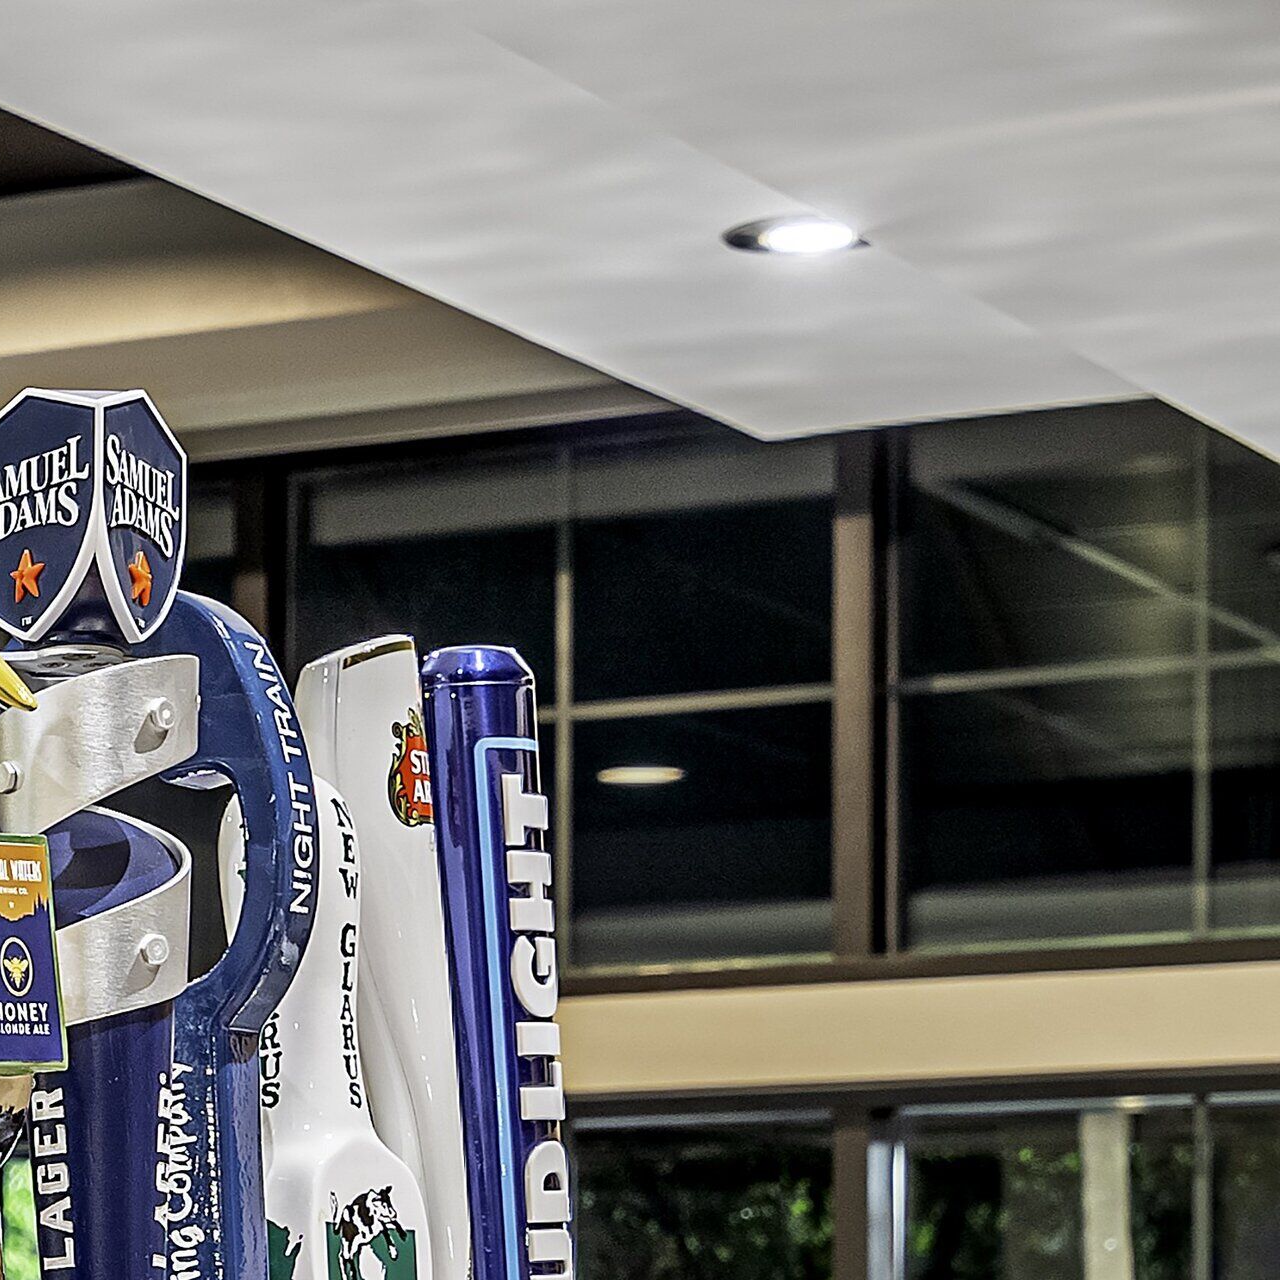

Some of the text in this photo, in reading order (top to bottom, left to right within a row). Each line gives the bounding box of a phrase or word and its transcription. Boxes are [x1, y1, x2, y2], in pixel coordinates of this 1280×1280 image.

[105, 434, 180, 522] SAMUEL
[109, 483, 174, 559] ADAMS
[243, 637, 314, 914] NIGHT TRAIN
[330, 798, 362, 1109] NEW GLARUS
[501, 773, 565, 1121] LIGHT
[32, 1023, 51, 1035] ALE
[259, 1020, 281, 1109] RUS
[31, 1087, 77, 1271] LAGER
[166, 1062, 198, 1222] Company
